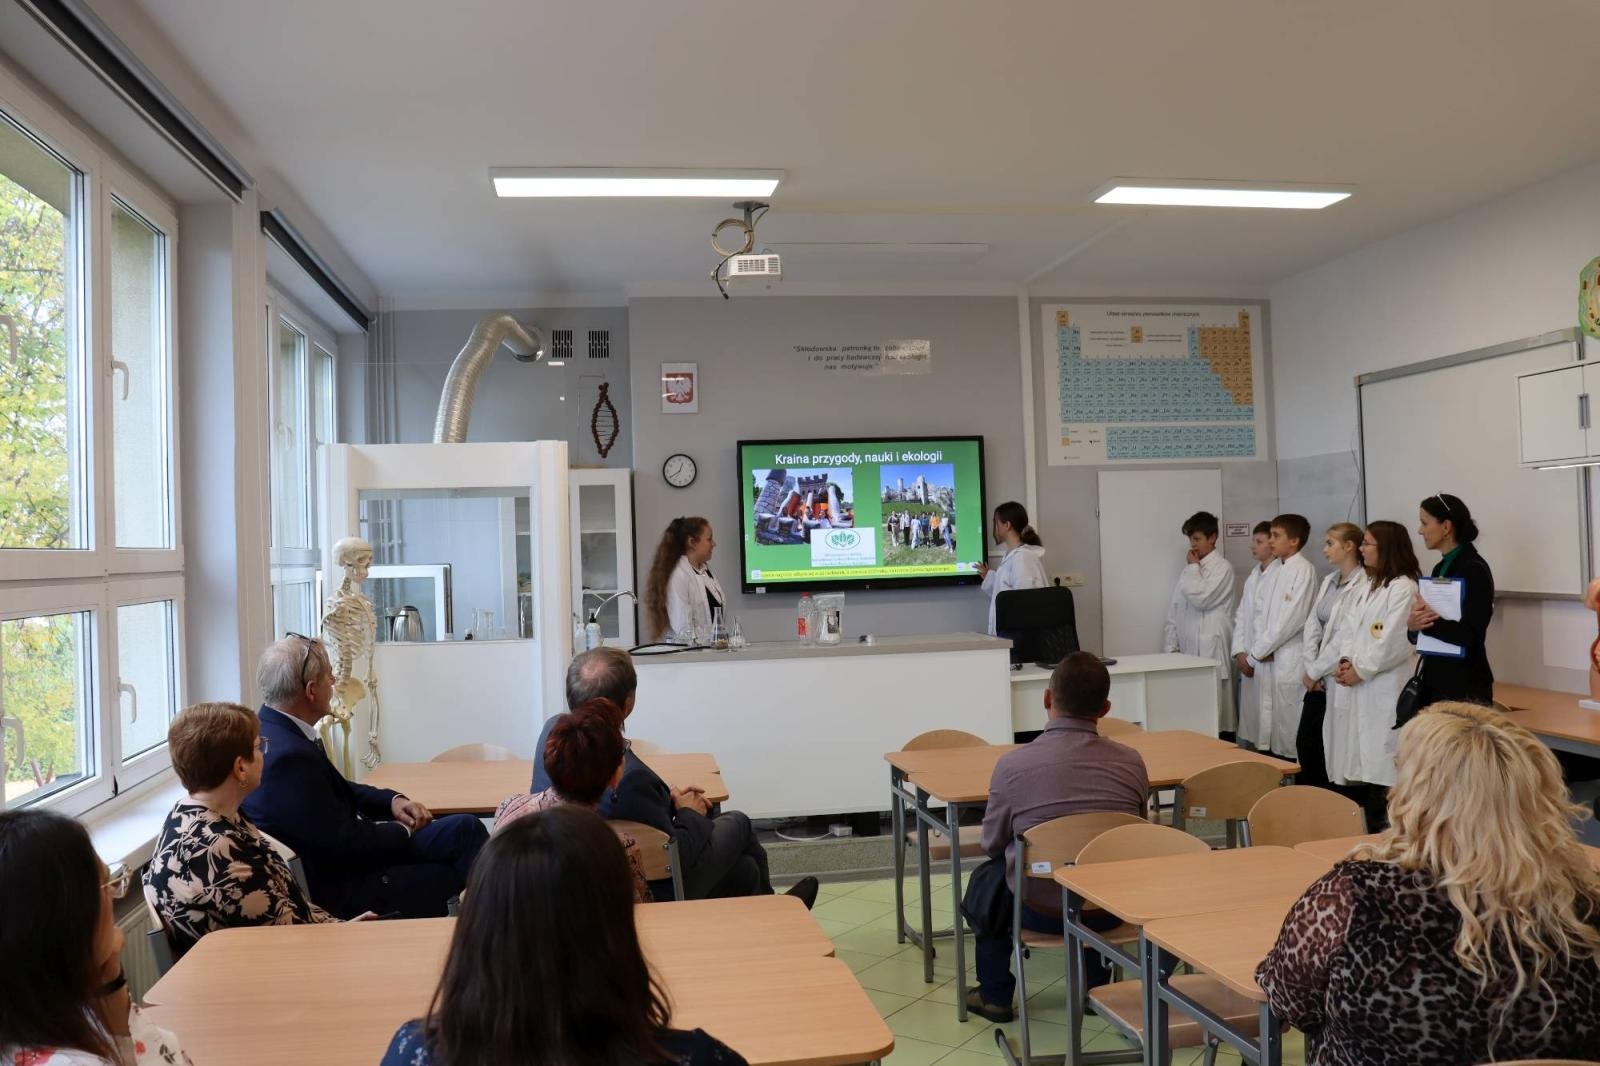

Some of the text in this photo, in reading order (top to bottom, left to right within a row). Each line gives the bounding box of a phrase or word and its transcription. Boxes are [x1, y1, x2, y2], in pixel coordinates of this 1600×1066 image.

[775, 450, 943, 466] Kraina przygody, nauki i ekologii
